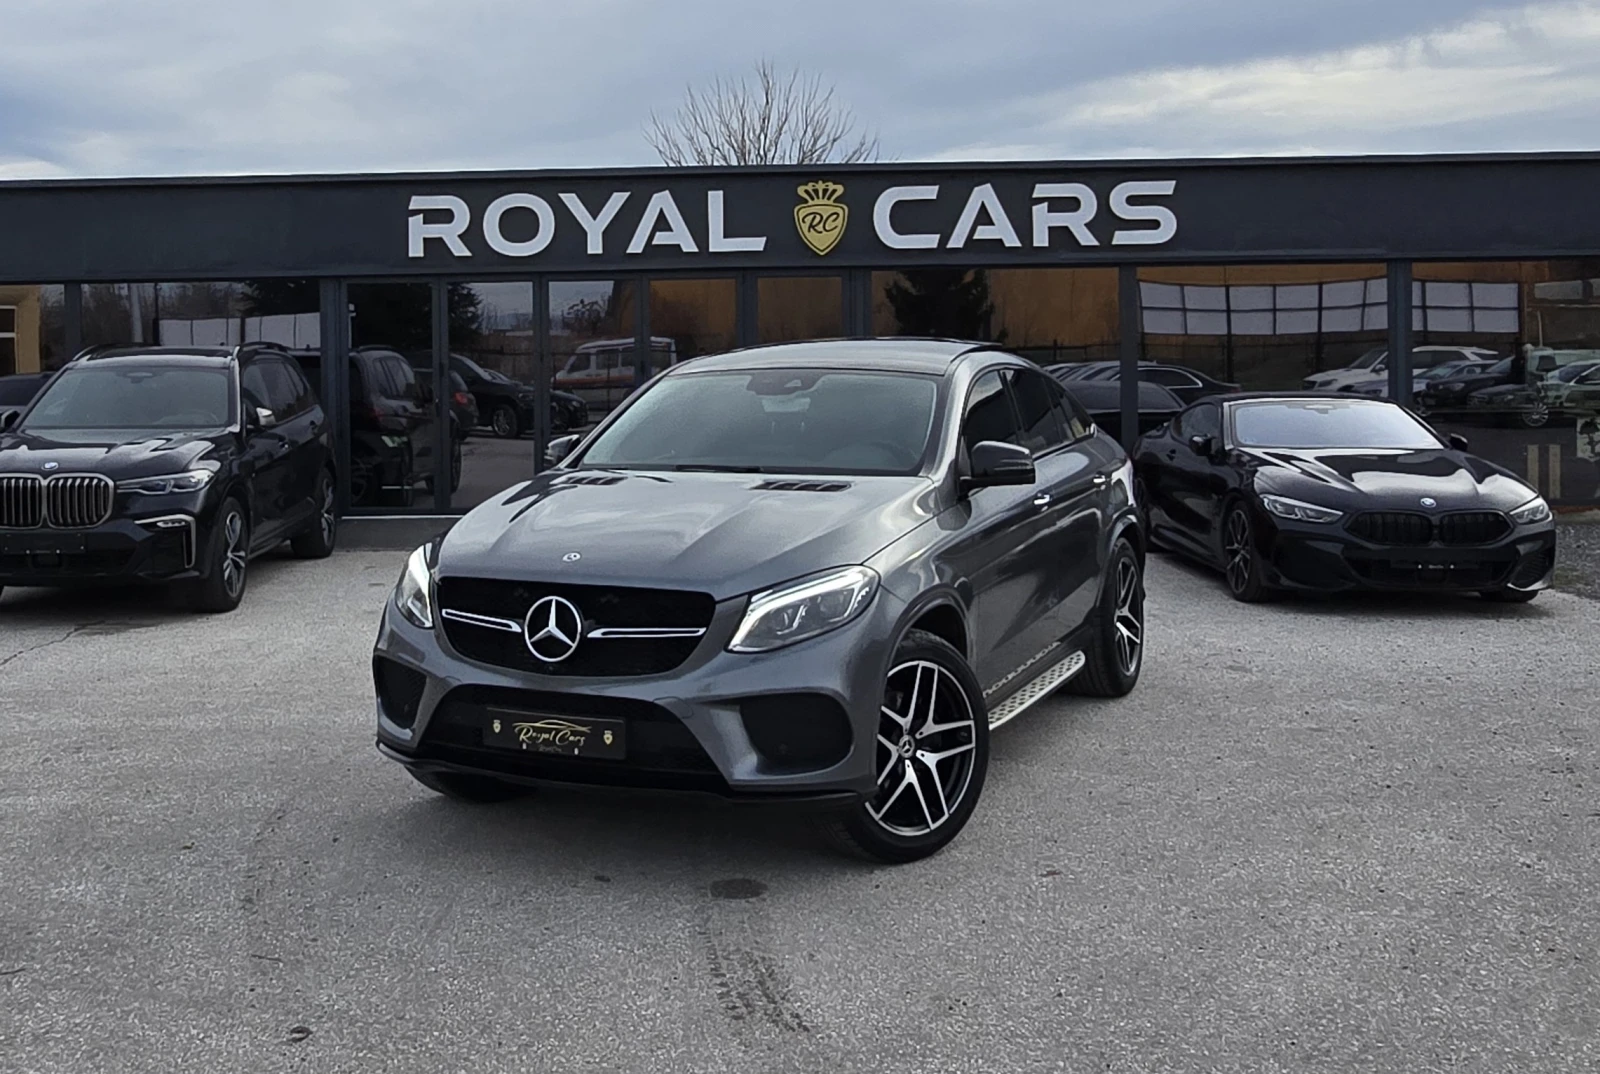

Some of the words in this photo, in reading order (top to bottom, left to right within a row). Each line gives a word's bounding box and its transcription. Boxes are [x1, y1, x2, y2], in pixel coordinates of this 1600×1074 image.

[408, 189, 767, 258] ROYAL
[872, 180, 1178, 250] CARS
[801, 211, 841, 234] RC
[514, 725, 556, 744] Royal
[555, 729, 586, 747] Cars
